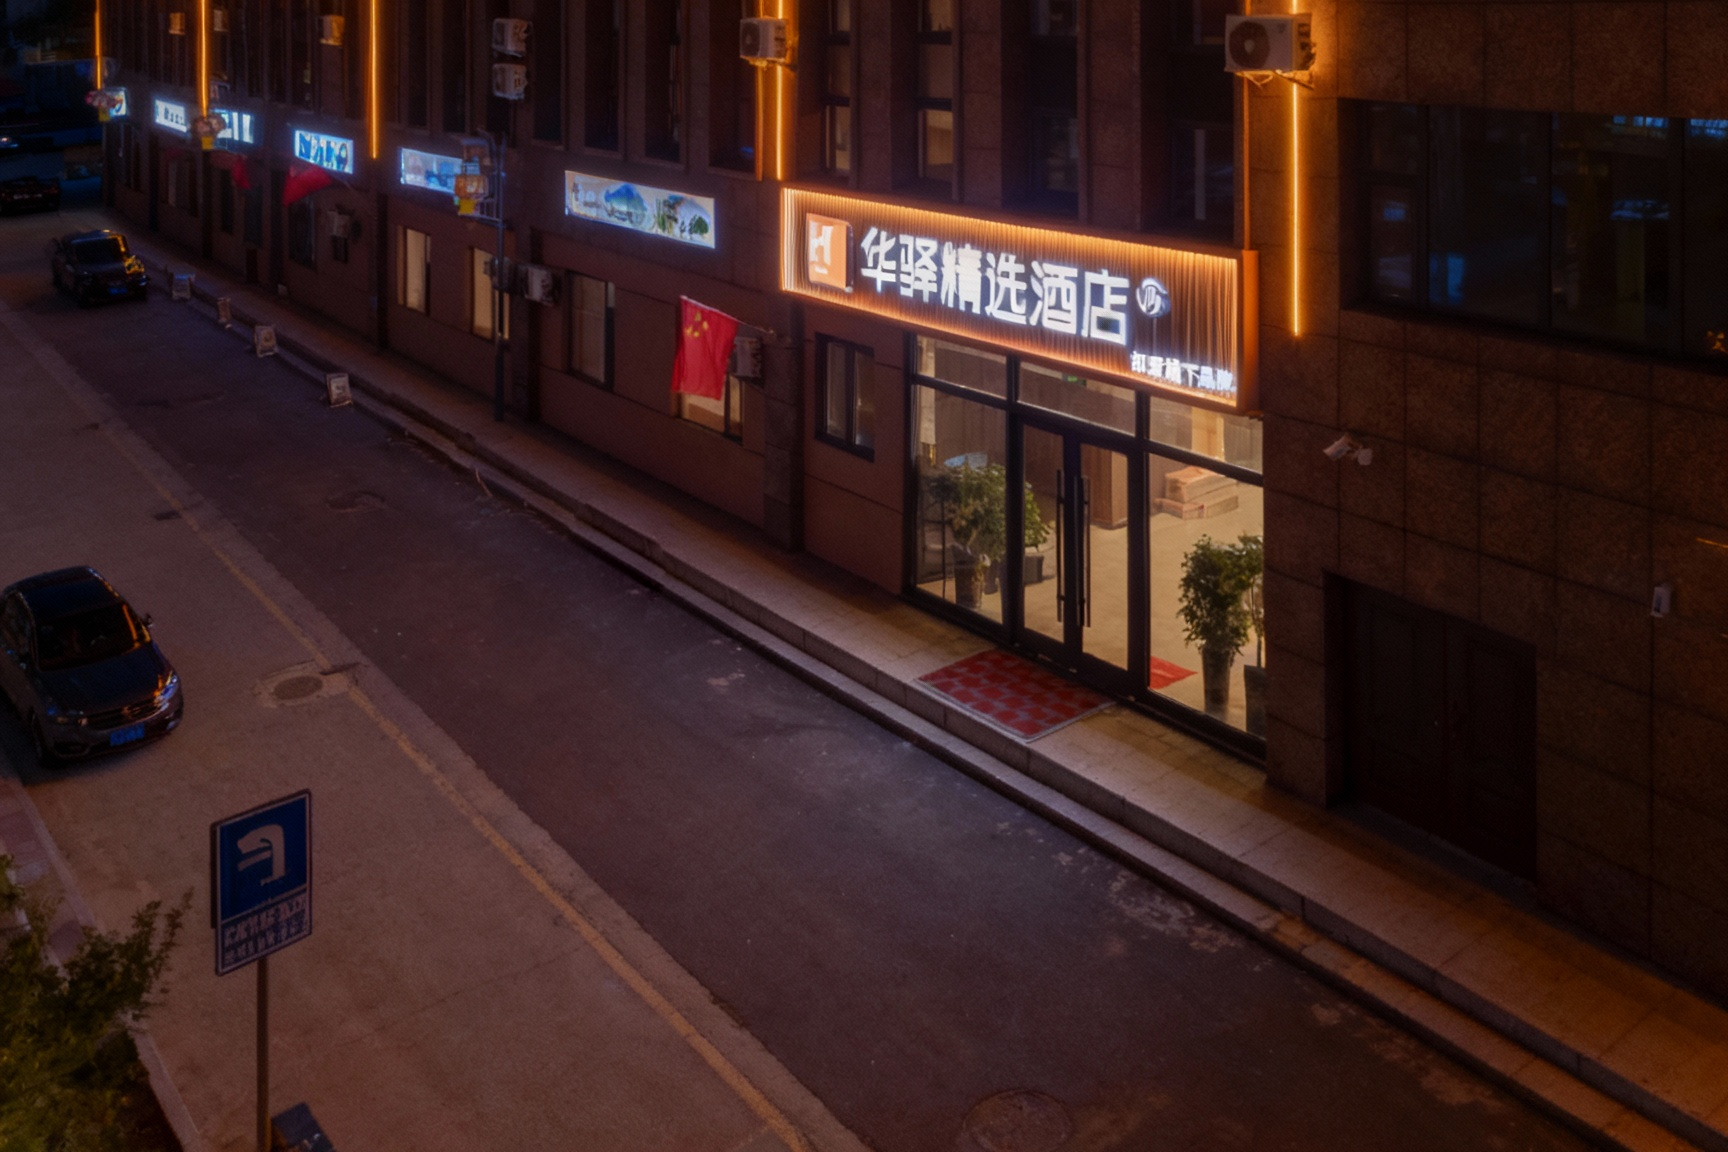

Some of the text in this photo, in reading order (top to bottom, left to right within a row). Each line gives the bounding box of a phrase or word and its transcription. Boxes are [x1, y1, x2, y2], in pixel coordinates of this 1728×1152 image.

[860, 227, 1130, 345] 华驿精选酒店
